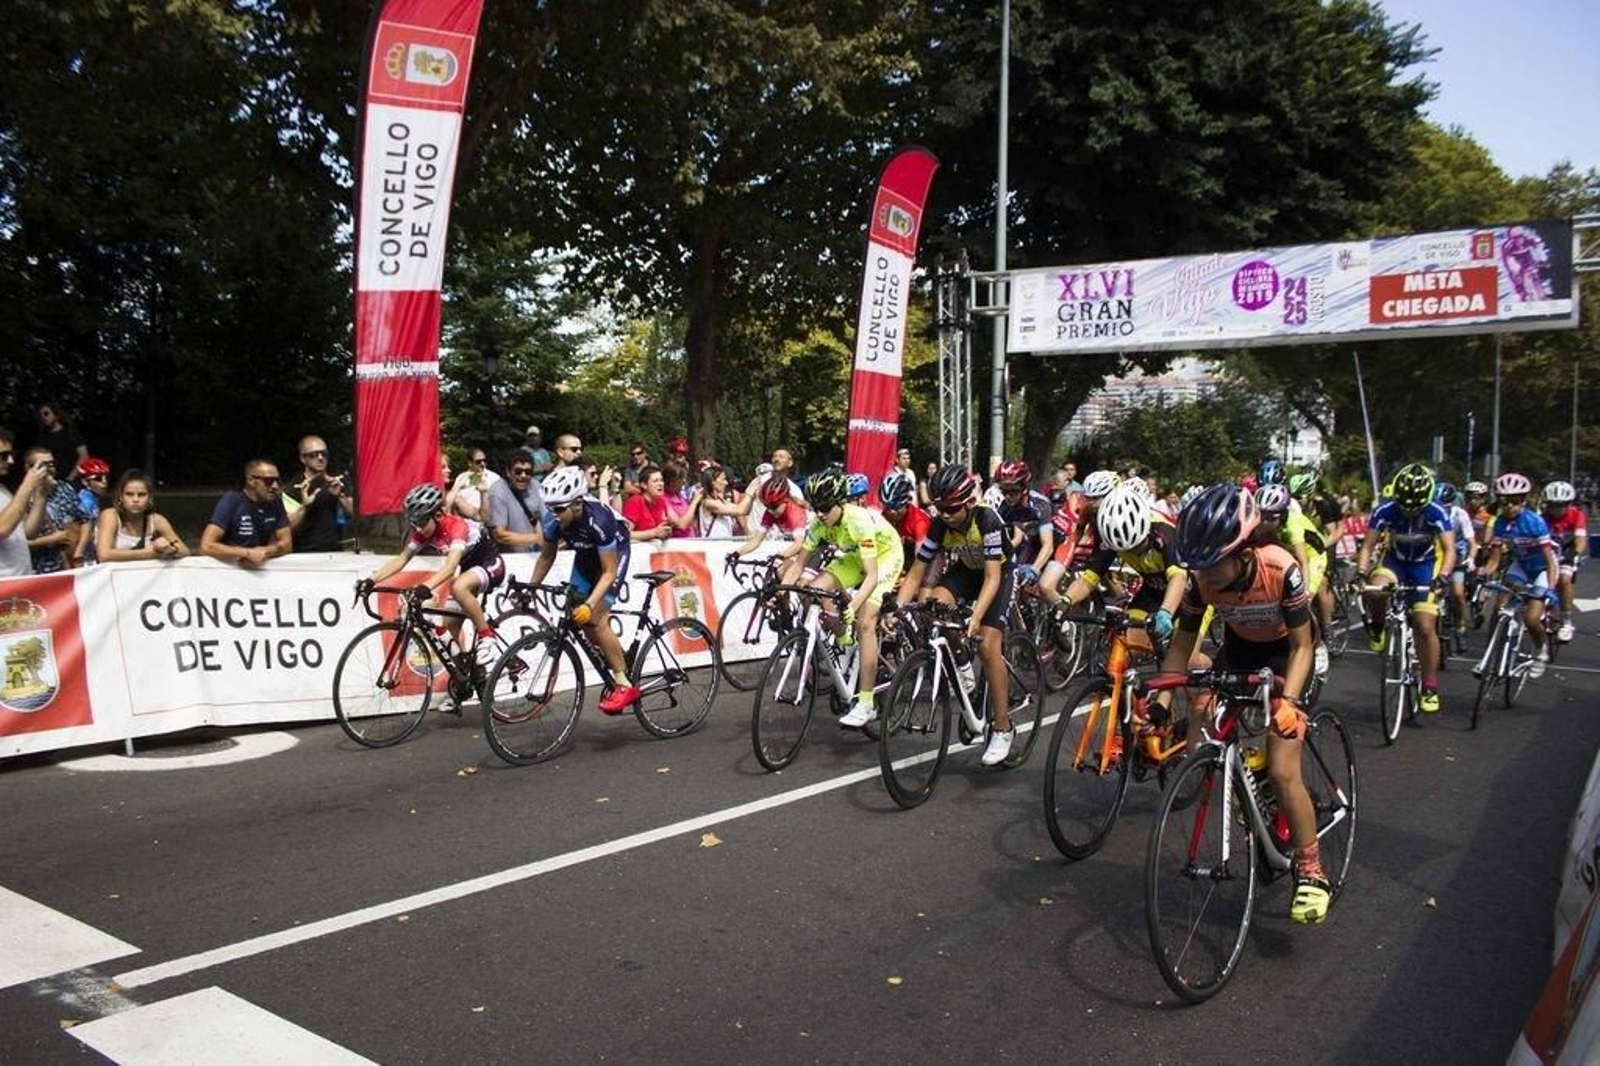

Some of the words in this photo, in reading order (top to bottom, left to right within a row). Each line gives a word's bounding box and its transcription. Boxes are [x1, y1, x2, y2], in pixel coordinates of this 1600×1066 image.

[413, 143, 439, 210] VIGO
[379, 123, 410, 276] CONCELLO
[409, 222, 431, 258] DE
[1057, 268, 1135, 301] XLVI
[1284, 276, 1307, 300] 24
[1403, 271, 1463, 293] META
[866, 256, 889, 362] CONCELLO
[1057, 299, 1133, 322] GRAN
[1284, 300, 1307, 325] 25
[1382, 293, 1486, 318] CHEGADA
[883, 327, 898, 353] DE
[1057, 320, 1135, 339] PREMIO
[140, 597, 341, 632] CONCELLO
[174, 639, 216, 673] DE
[233, 638, 324, 671] VIGO
